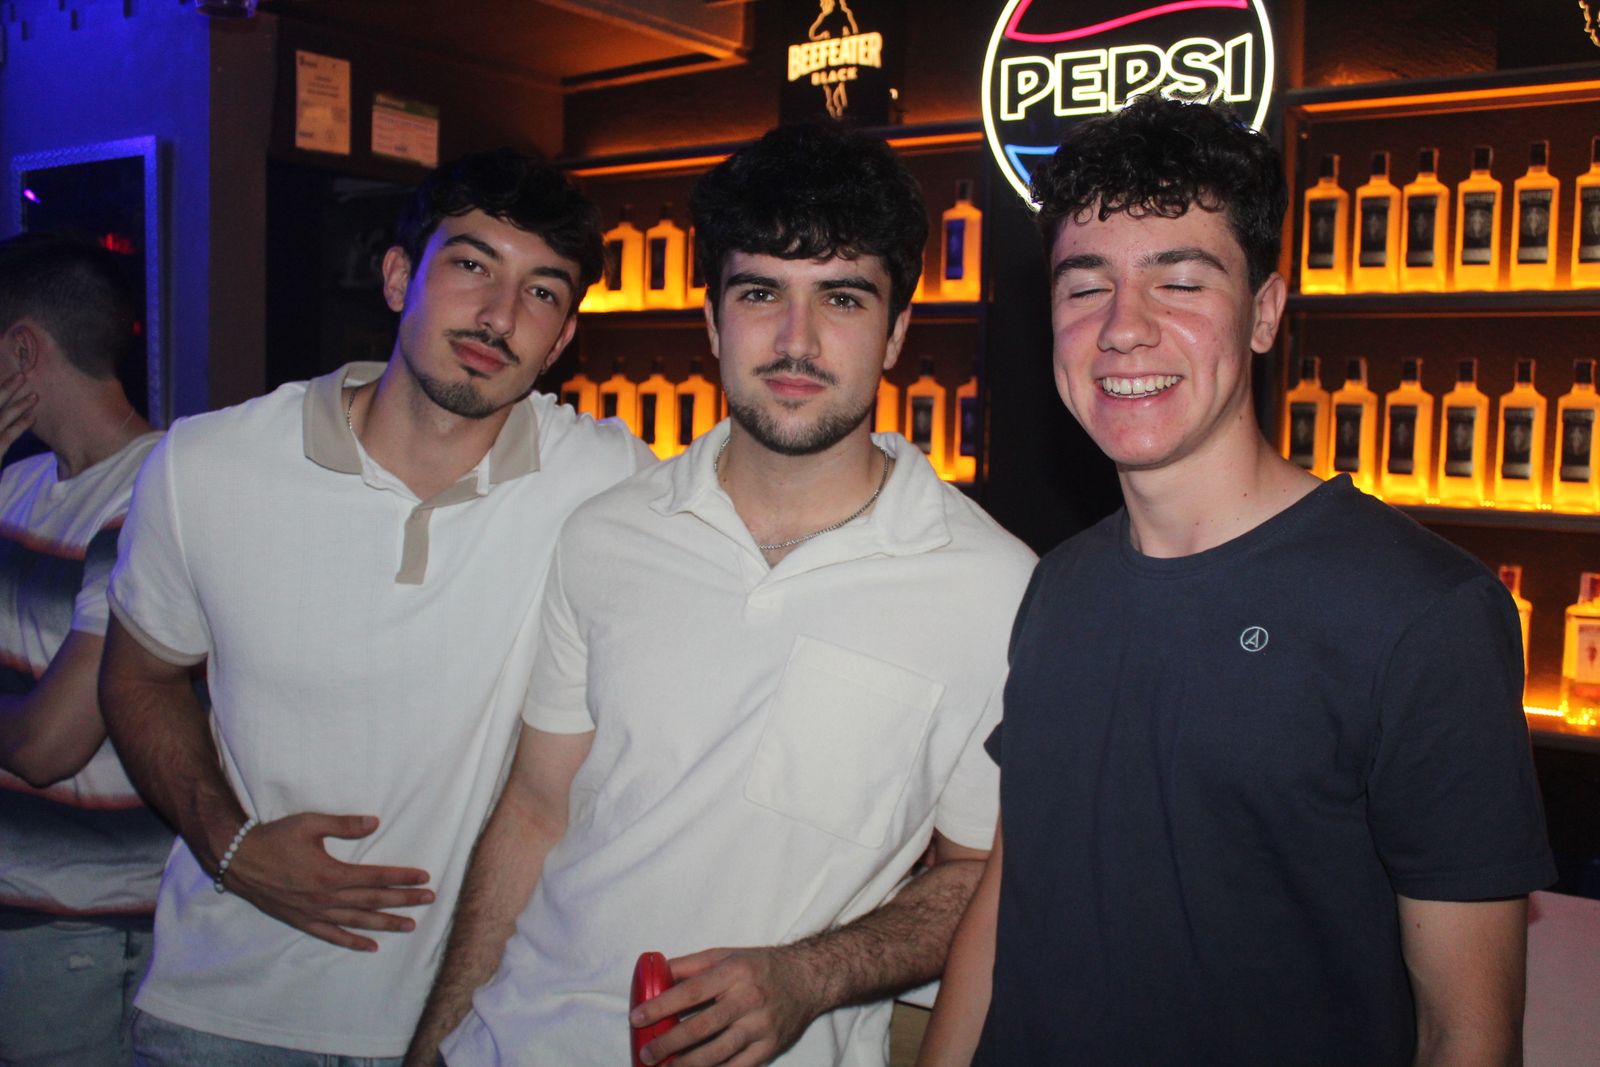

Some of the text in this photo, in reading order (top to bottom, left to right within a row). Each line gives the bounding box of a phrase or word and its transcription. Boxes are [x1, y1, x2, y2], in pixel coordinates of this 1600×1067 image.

[788, 31, 882, 81] BEEFEATER
[811, 66, 858, 86] BLACK
[1000, 33, 1253, 121] PEPSI
